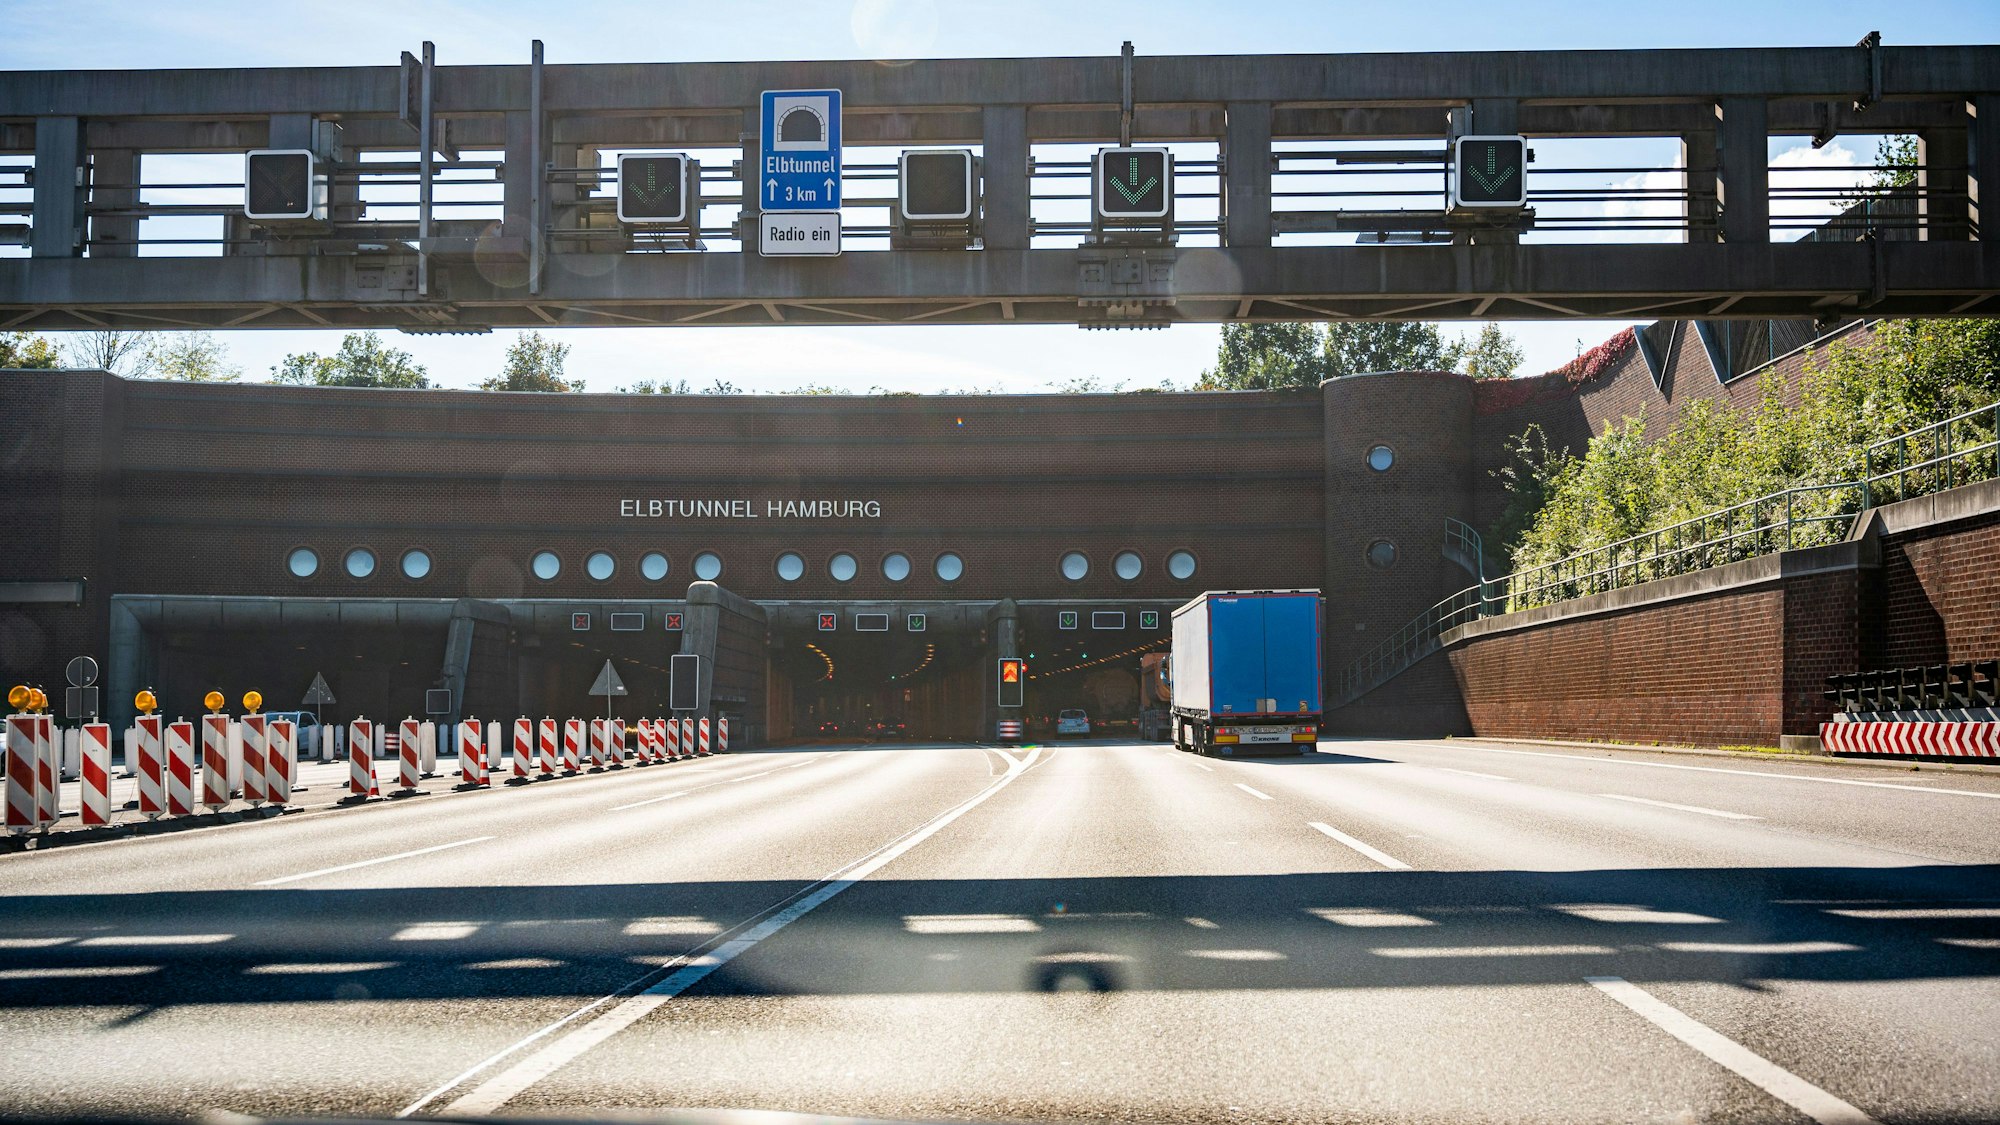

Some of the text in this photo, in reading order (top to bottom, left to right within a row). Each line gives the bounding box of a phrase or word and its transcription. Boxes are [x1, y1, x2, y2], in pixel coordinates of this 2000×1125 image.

[766, 156, 835, 173] Elbtunnel
[785, 186, 816, 202] 3 km
[770, 226, 830, 241] Radio ein
[620, 499, 881, 518] ELBTUNNEL HAMBURG
